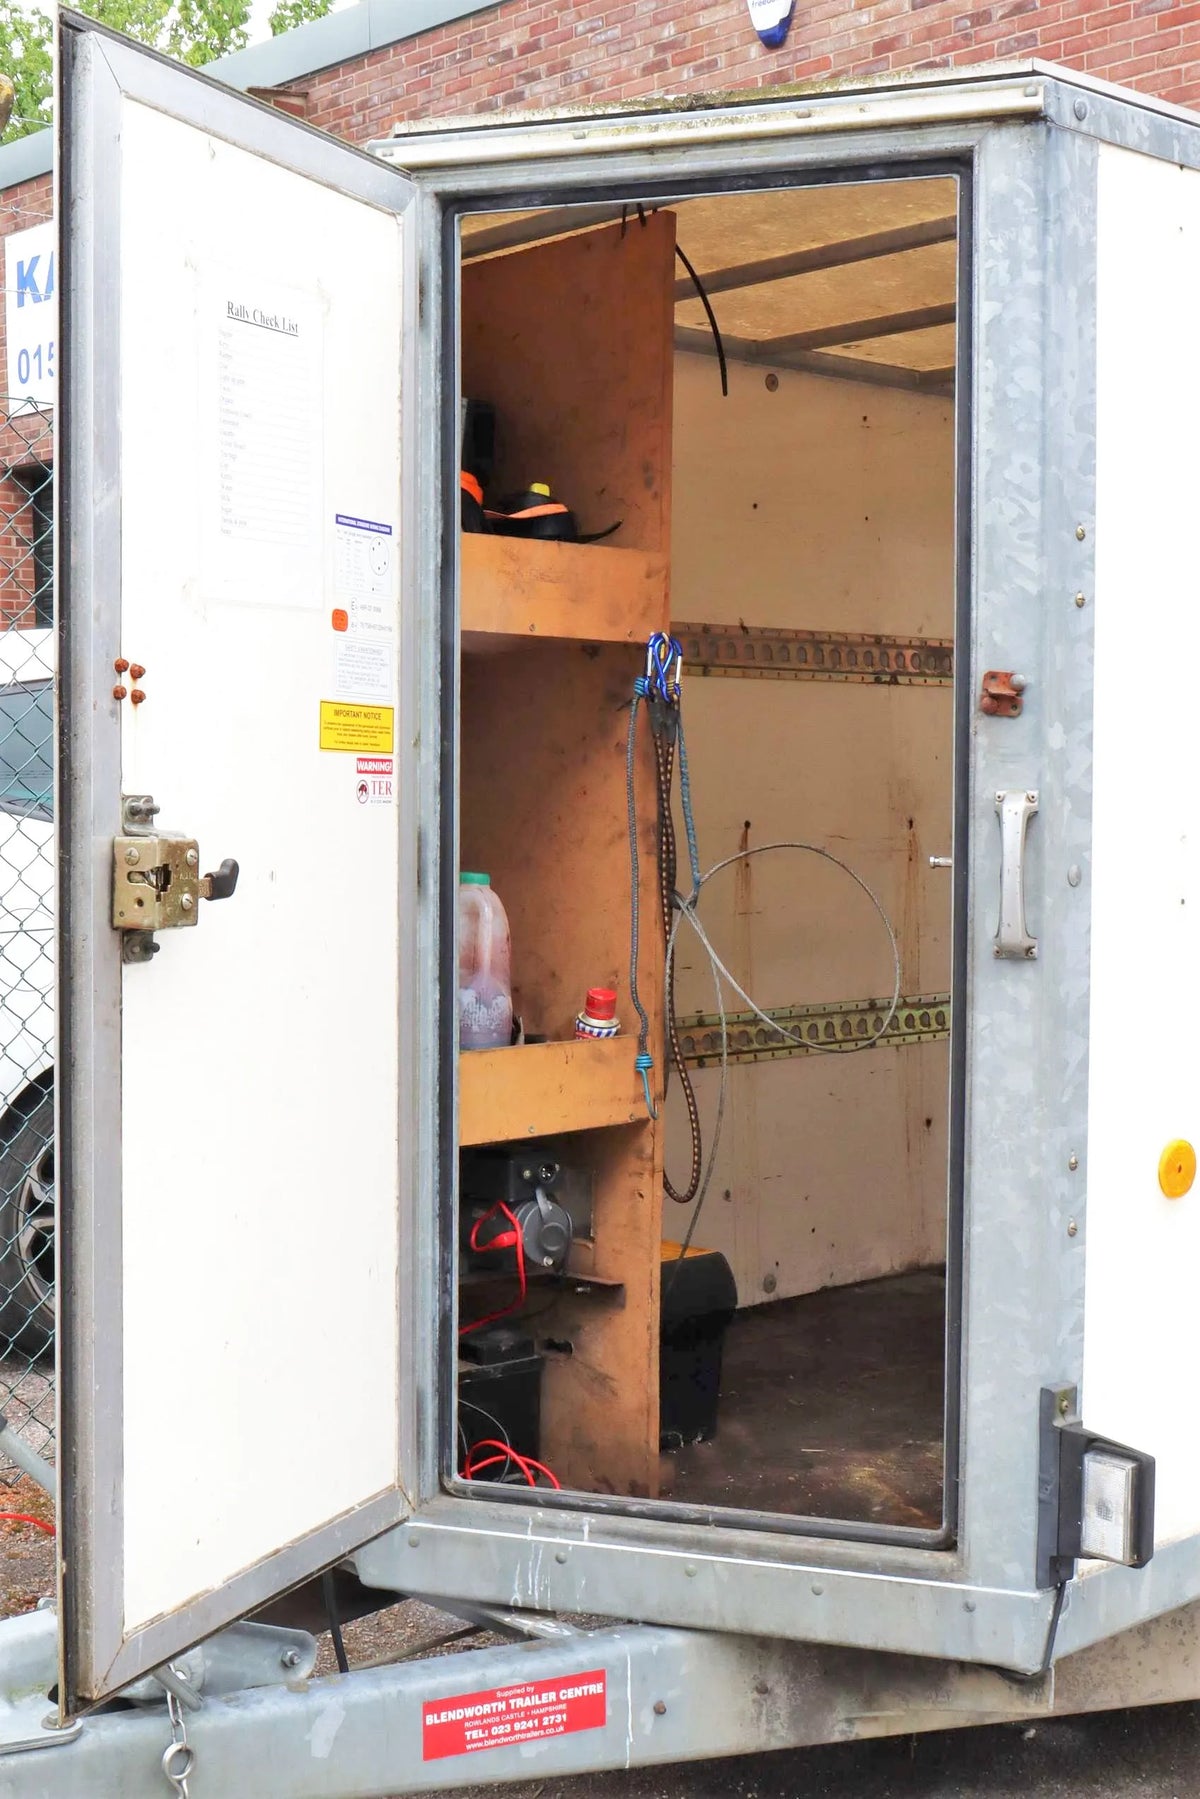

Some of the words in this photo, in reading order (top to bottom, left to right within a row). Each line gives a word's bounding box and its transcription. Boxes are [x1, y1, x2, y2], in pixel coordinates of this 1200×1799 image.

[227, 300, 250, 319] Rally
[252, 308, 279, 329] Check
[282, 317, 298, 334] List
[334, 709, 362, 720] IMPORTANT
[363, 712, 382, 721] NOTICE
[357, 761, 392, 772] WARNING!
[371, 780, 392, 795] TER
[426, 1702, 505, 1725] BLENDWORTH
[509, 1691, 556, 1710] TRAILER
[560, 1682, 603, 1700] CENTRE
[496, 1687, 525, 1698] Supplied
[526, 1685, 535, 1694] by
[464, 1715, 500, 1728] ROWLANDS
[501, 1711, 525, 1722] CASTLE
[531, 1703, 568, 1716] HAMPSHIRE
[464, 1728, 489, 1741] TEL:
[491, 1722, 511, 1735] 023
[513, 1719, 539, 1731] 9241
[542, 1713, 568, 1727] 2731
[466, 1725, 564, 1750] www.blendworthtrailers.co.uk
